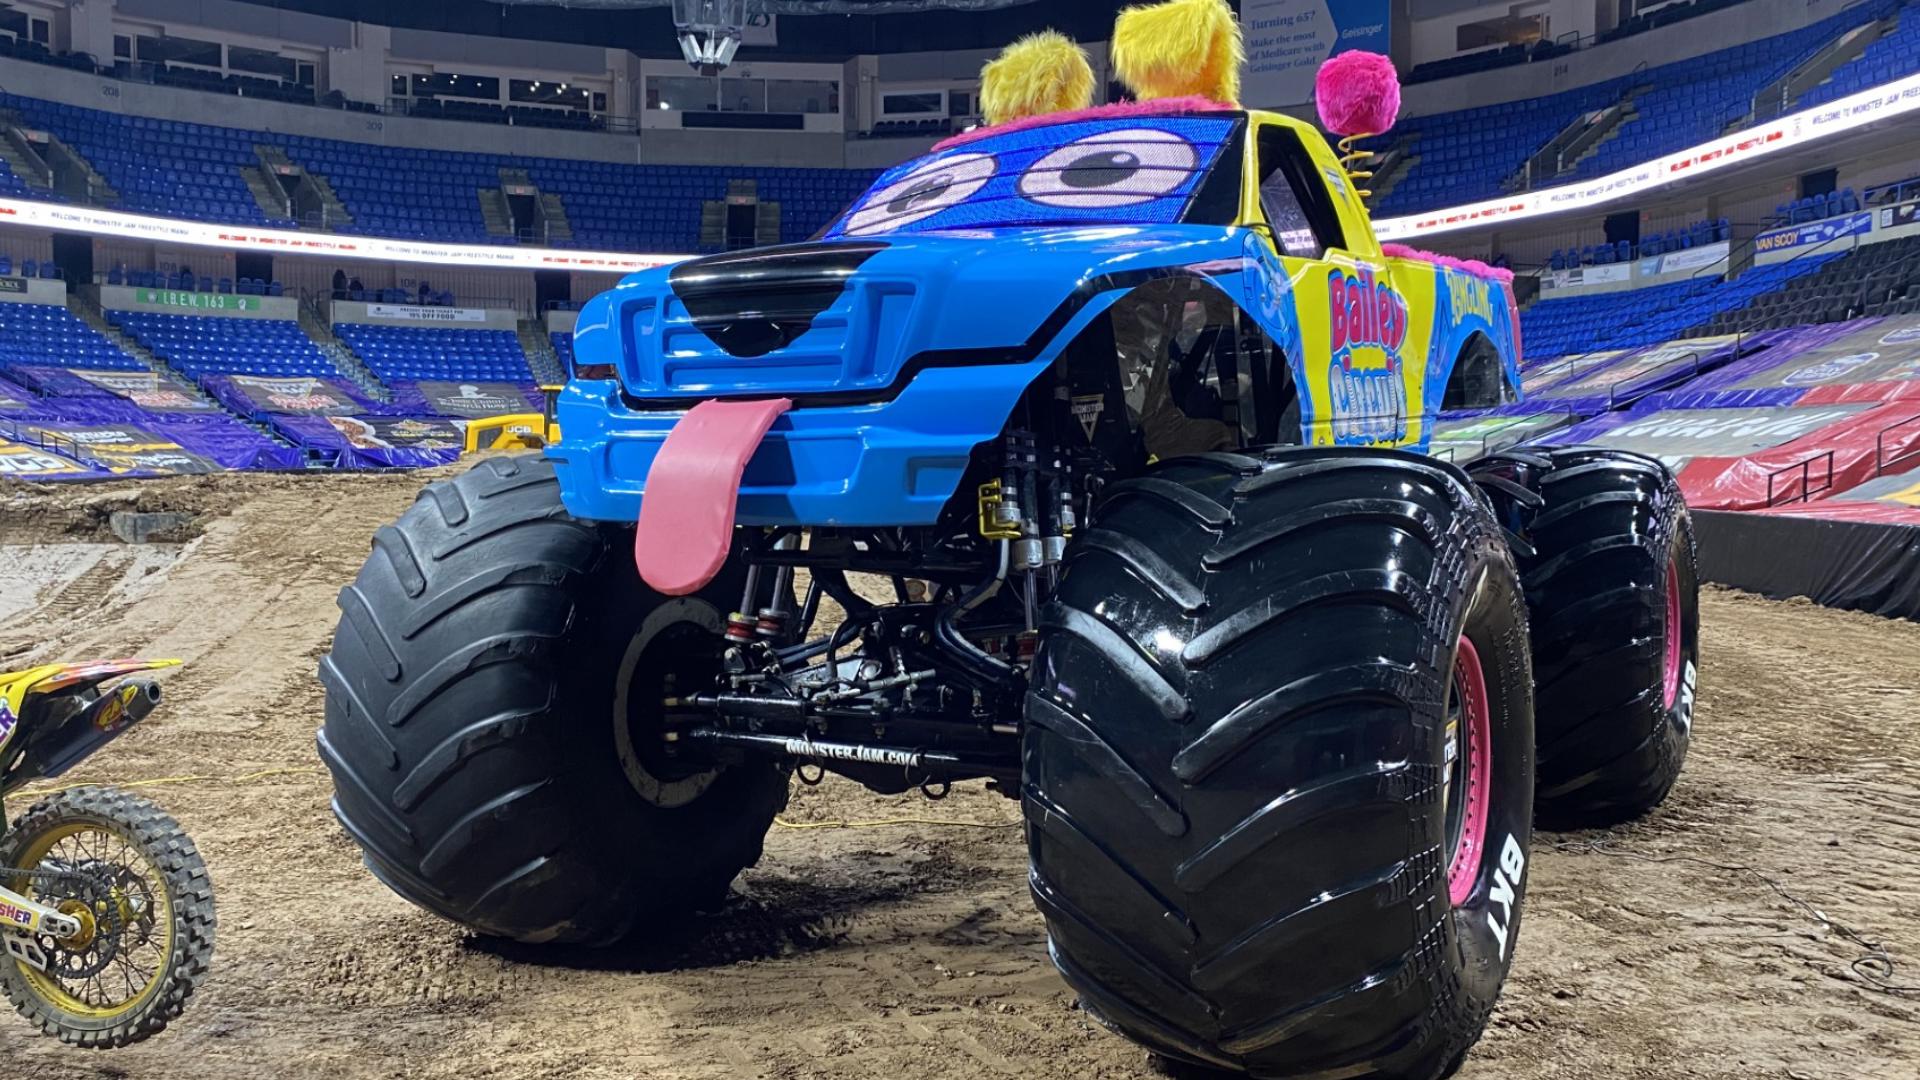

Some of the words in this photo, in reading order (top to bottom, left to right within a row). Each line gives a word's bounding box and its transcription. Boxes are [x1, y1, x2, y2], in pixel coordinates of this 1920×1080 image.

[1252, 15, 1294, 30] Turning
[1296, 10, 1316, 23] 65?
[1342, 23, 1384, 39] Geisinger
[1251, 39, 1273, 49] Make
[1276, 34, 1291, 44] the
[1293, 31, 1316, 43] most
[1260, 48, 1301, 60] Medicare
[1252, 61, 1292, 73] Geisinger
[1294, 56, 1316, 67] Gold
[1812, 111, 1841, 125] WELCOME
[1852, 98, 1883, 115] MONSTER
[1885, 92, 1900, 106] JAM
[51, 211, 81, 223] WELCOME
[93, 218, 122, 228] MONSTER
[1755, 238, 1773, 249] VAN
[1774, 231, 1800, 247] SCOY
[203, 295, 225, 309] 163
[1329, 257, 1408, 354] Bailey
[1071, 403, 1104, 413] MONSTER
[1080, 413, 1098, 422] JAM
[507, 425, 532, 433] JCB
[1684, 660, 1697, 737] BKT
[1487, 833, 1525, 963] BKT
